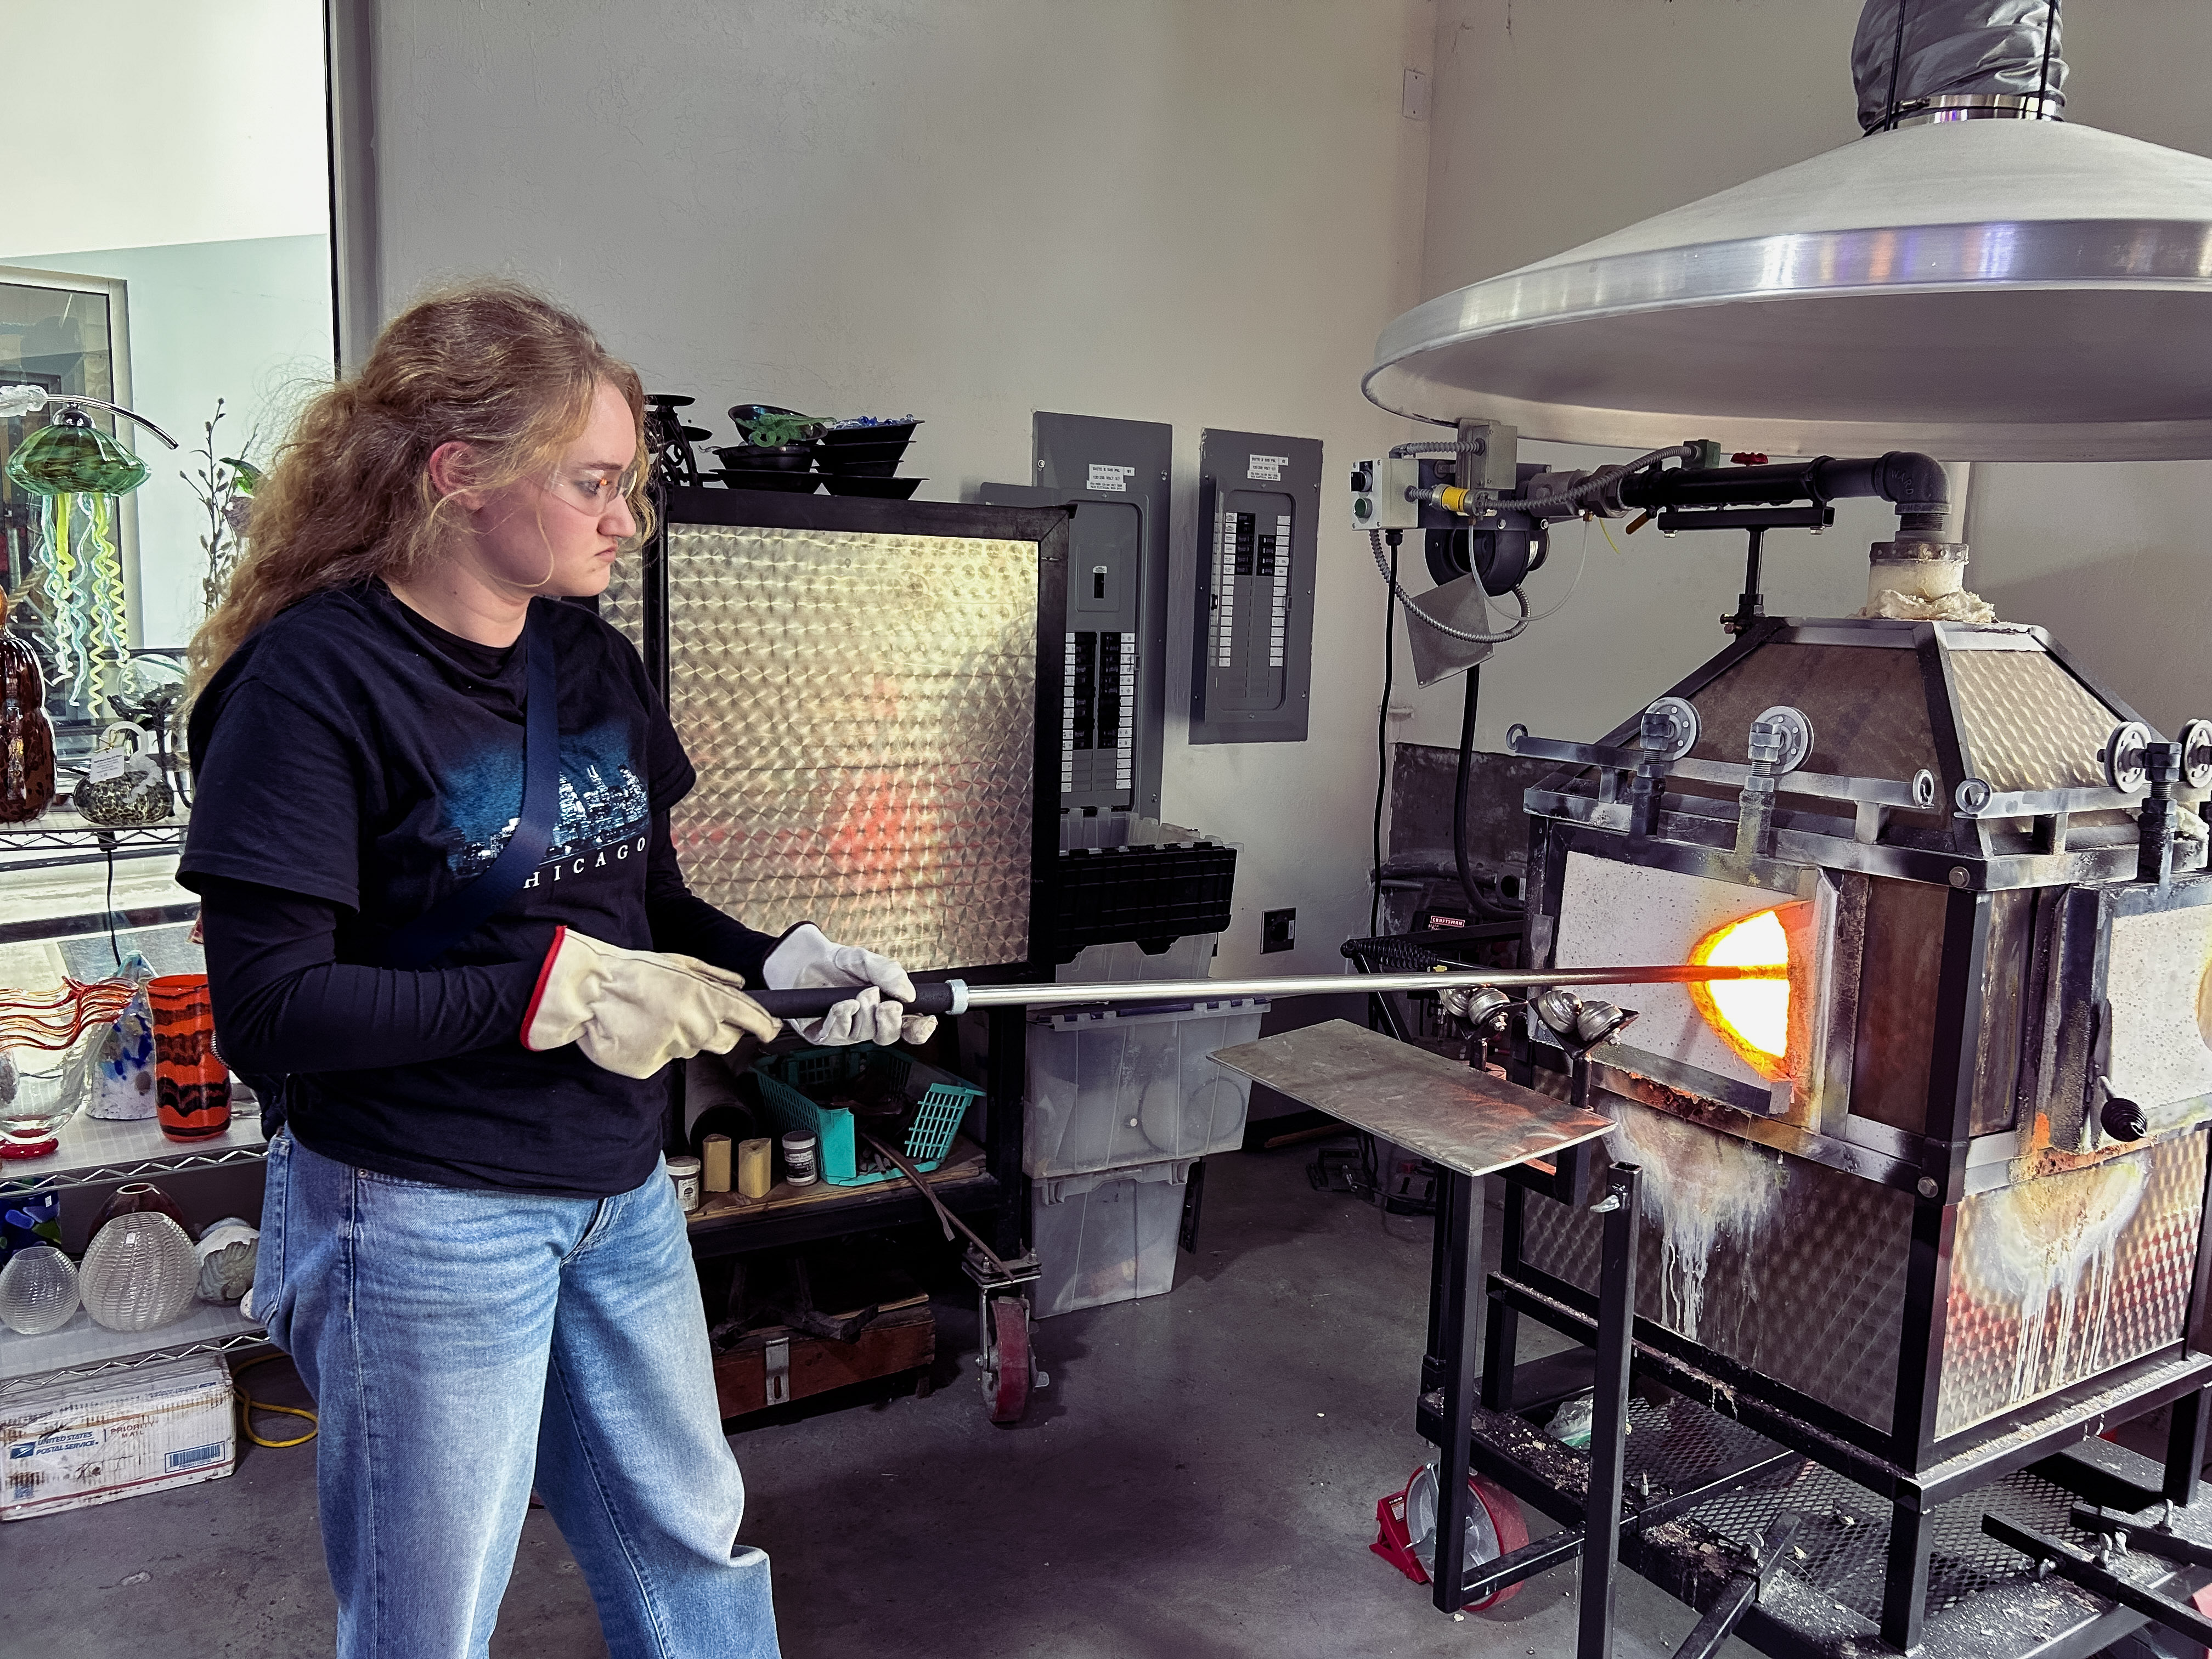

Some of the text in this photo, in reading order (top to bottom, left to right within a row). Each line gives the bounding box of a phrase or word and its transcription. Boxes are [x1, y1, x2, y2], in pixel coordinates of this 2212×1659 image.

[1891, 469, 1914, 494] WARD
[523, 837, 646, 889] HICAGO
[1432, 917, 1463, 926] CRAFTSMAN
[110, 1420, 154, 1434] PRIORITY
[121, 1430, 145, 1438] MAIL
[37, 1431, 93, 1446] UNITED STATES
[36, 1445, 64, 1455] POSTAL
